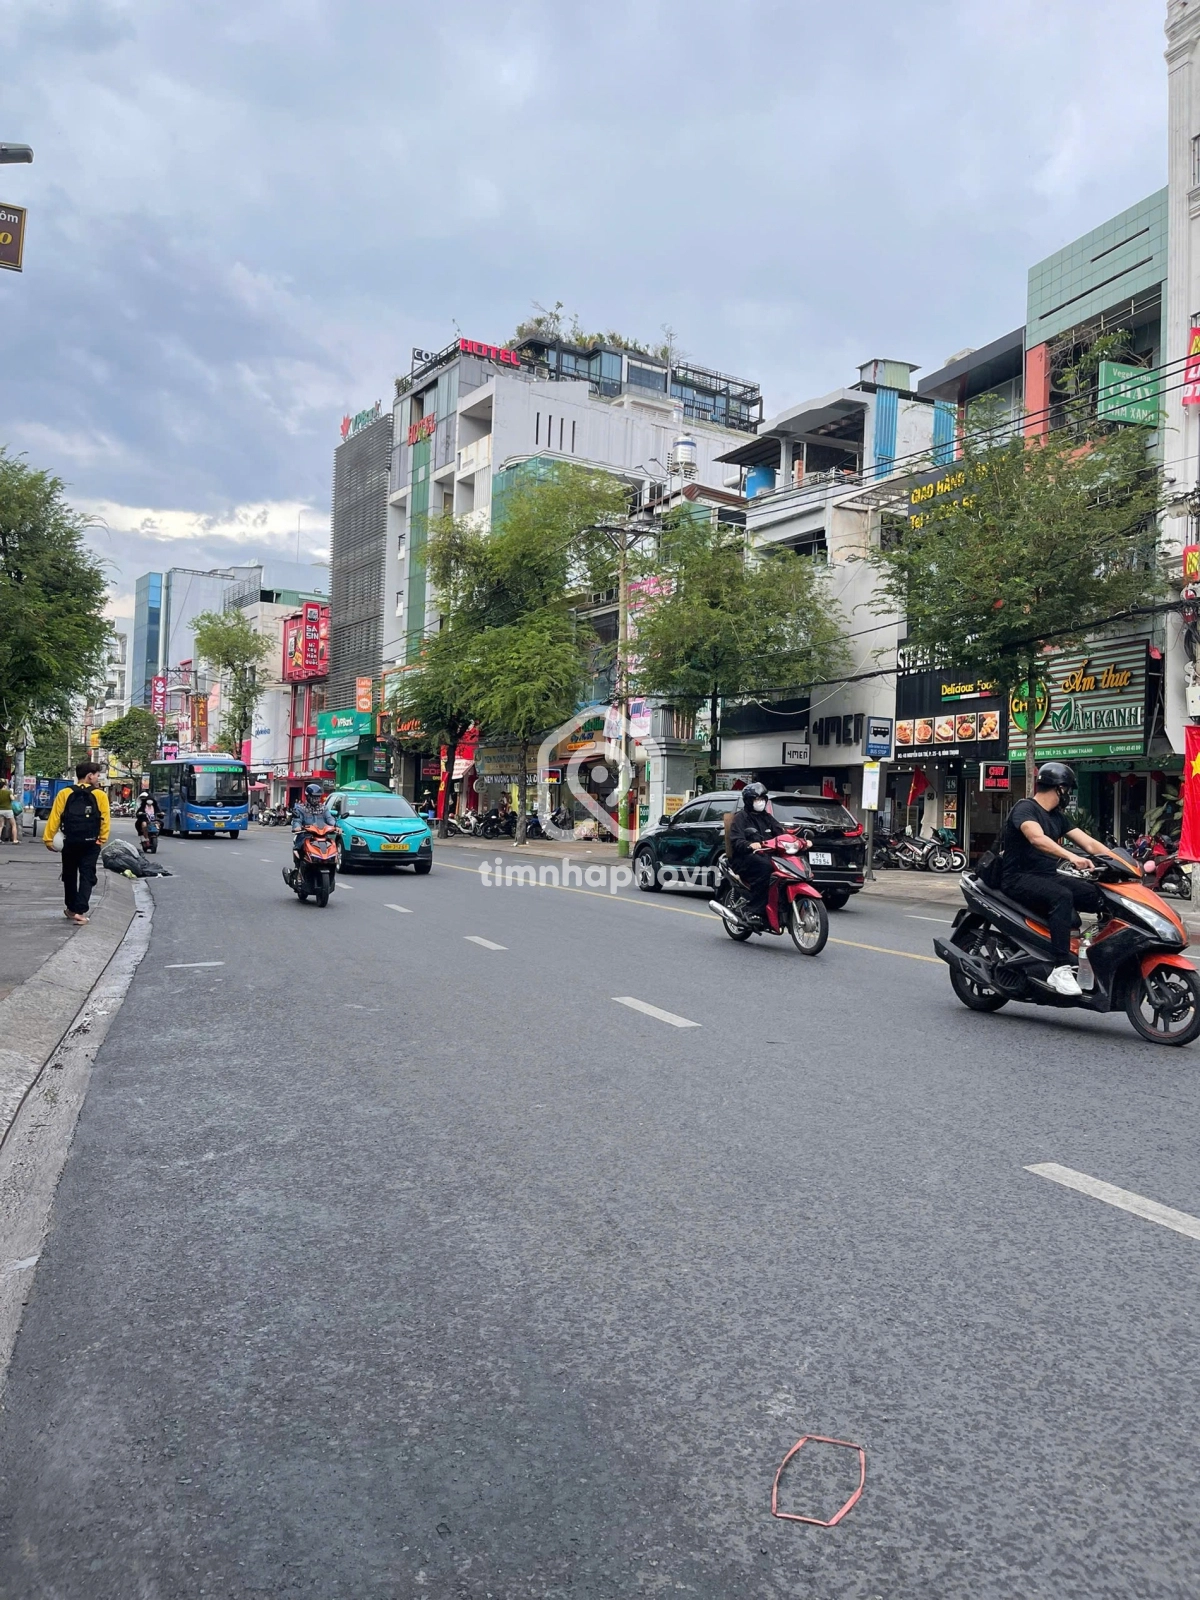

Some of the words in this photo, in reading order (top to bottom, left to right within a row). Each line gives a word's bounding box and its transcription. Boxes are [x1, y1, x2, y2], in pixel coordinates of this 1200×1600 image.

[460, 338, 520, 366] HOTEL
[1108, 382, 1153, 402] CHAY
[407, 412, 436, 446] HOTEL
[911, 483, 934, 504] GIAO
[941, 683, 974, 696] Delicious
[1012, 698, 1044, 713] CHY
[1097, 706, 1141, 729] XANH
[812, 713, 865, 746] 4MEN
[787, 750, 808, 759] 4MEN
[926, 792, 935, 800] 50
